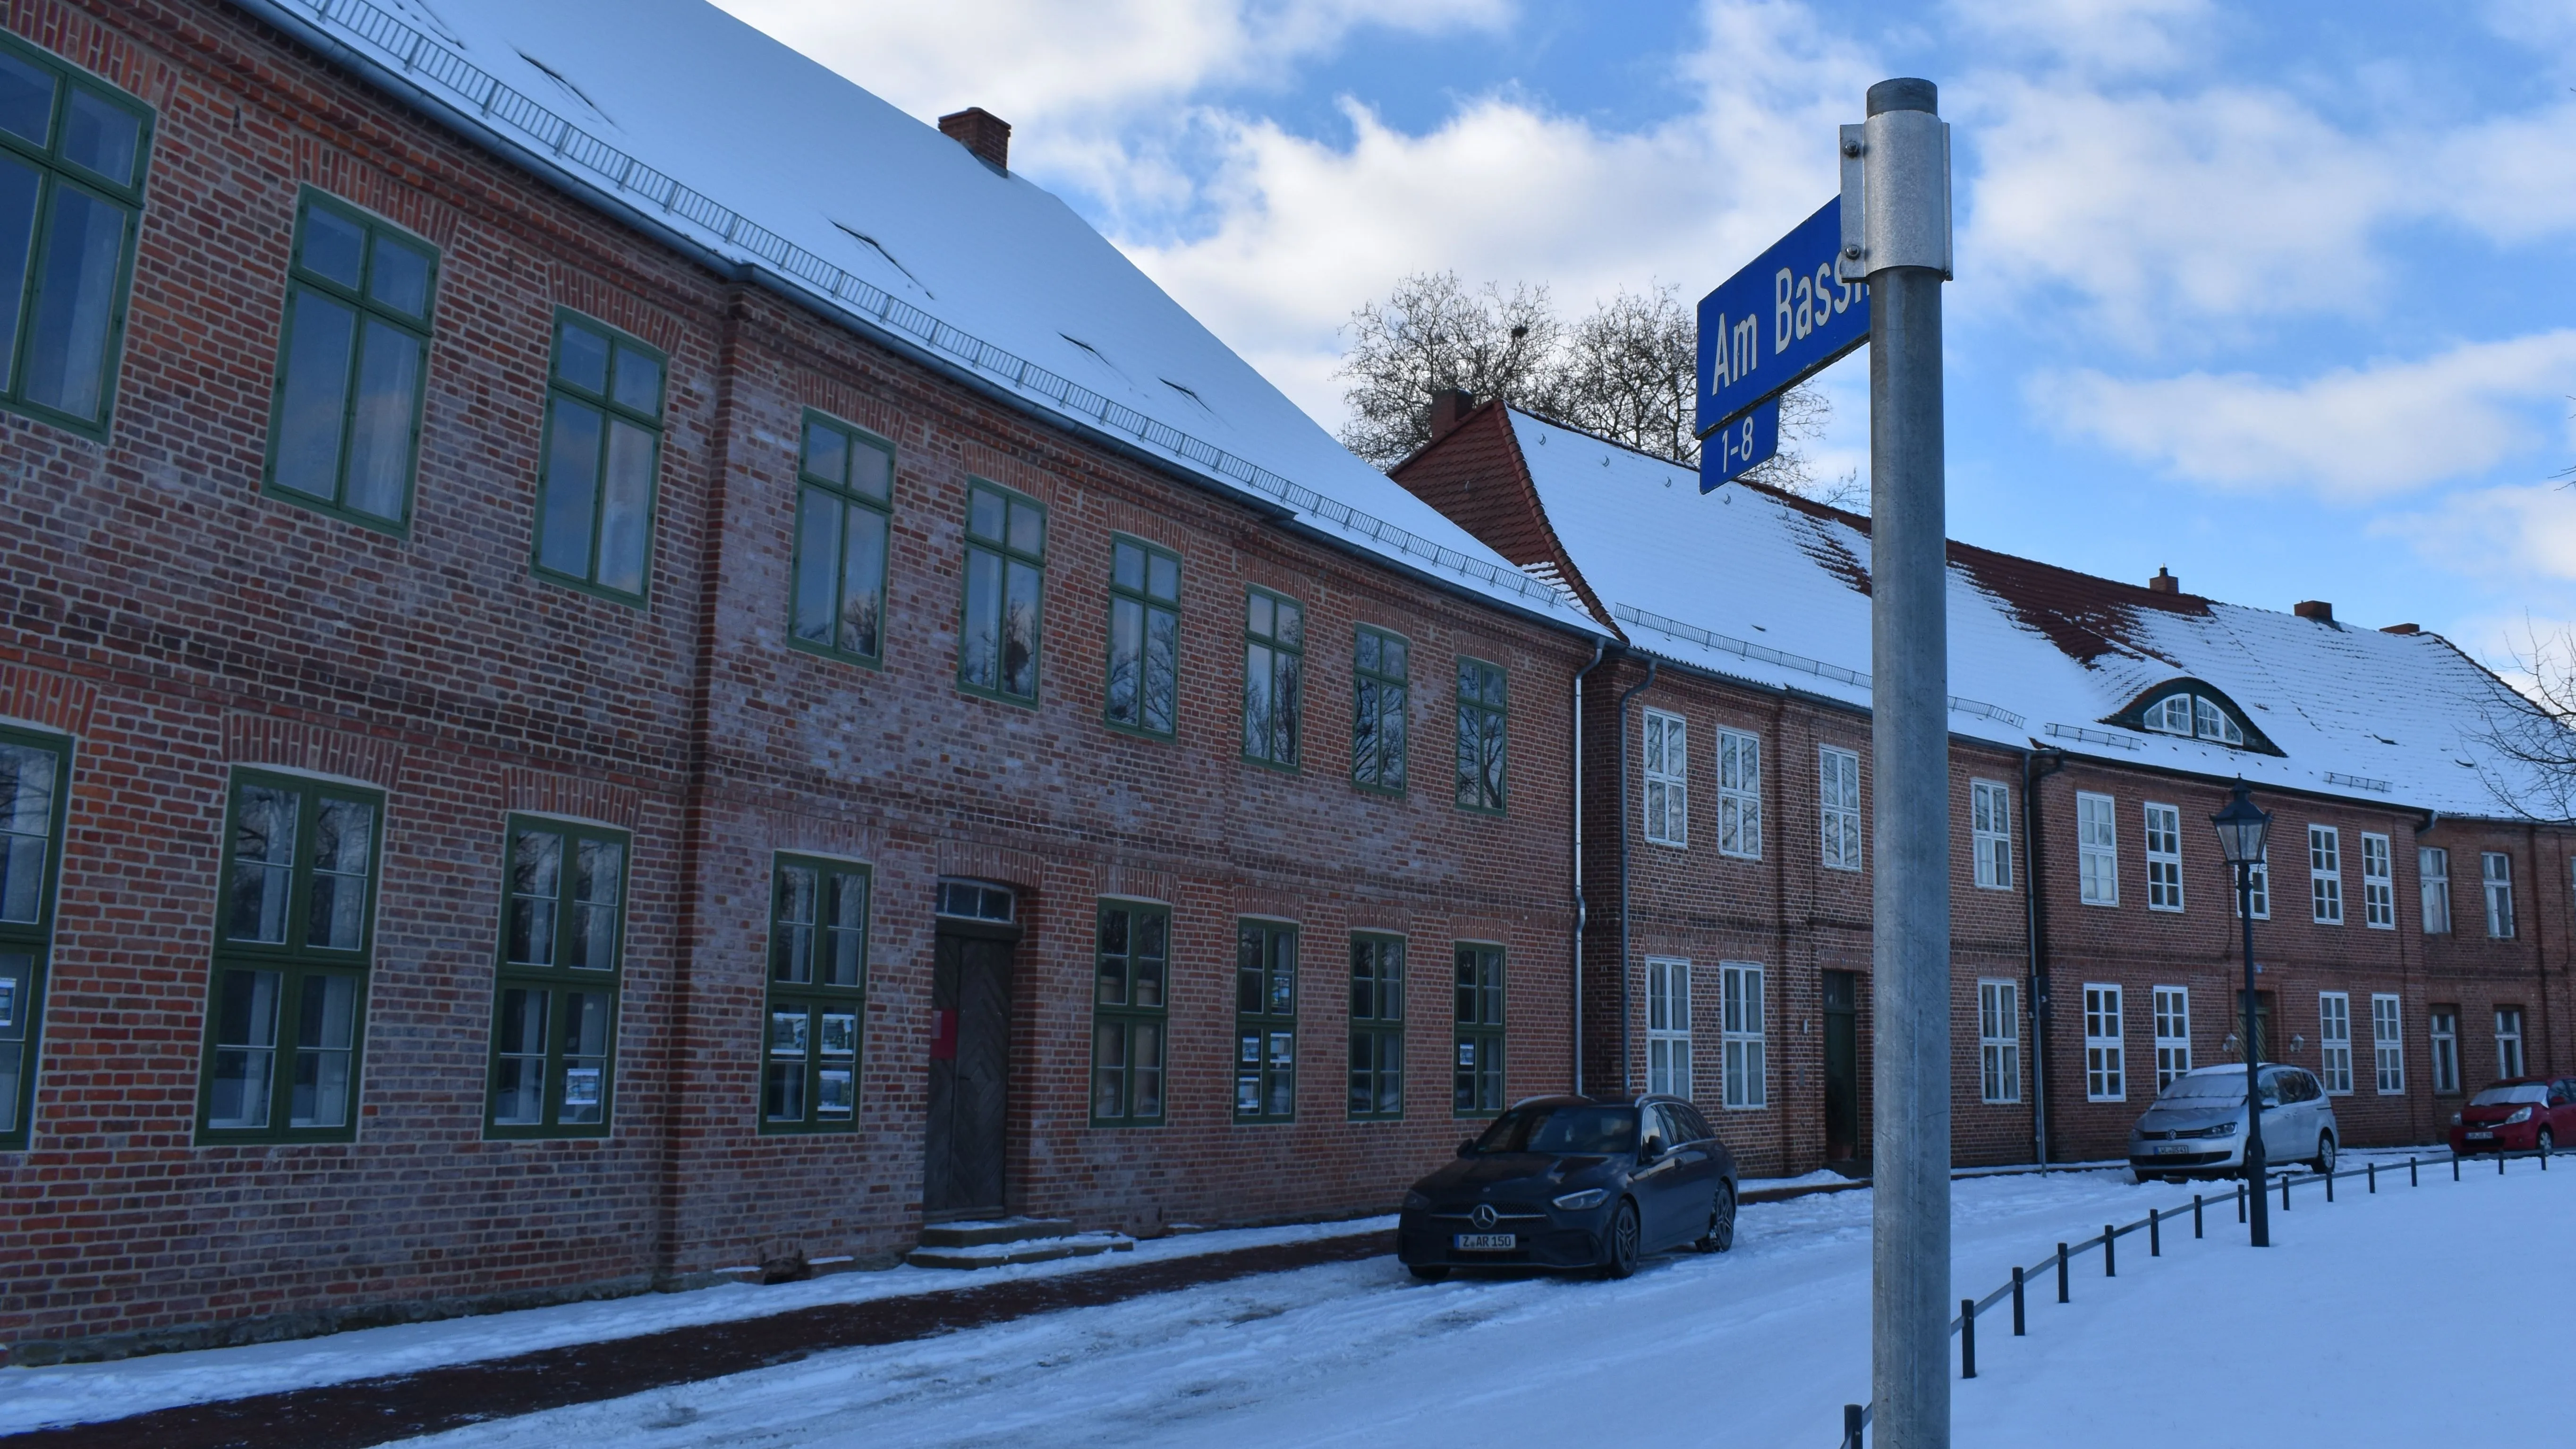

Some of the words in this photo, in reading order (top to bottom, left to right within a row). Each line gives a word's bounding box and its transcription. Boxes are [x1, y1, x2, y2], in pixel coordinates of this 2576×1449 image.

[1712, 313, 1757, 396] Am
[1776, 251, 1870, 355] Bass
[1722, 416, 1753, 473] 1-8
[1476, 1236, 1489, 1247] AR
[1492, 1236, 1511, 1246] 150
